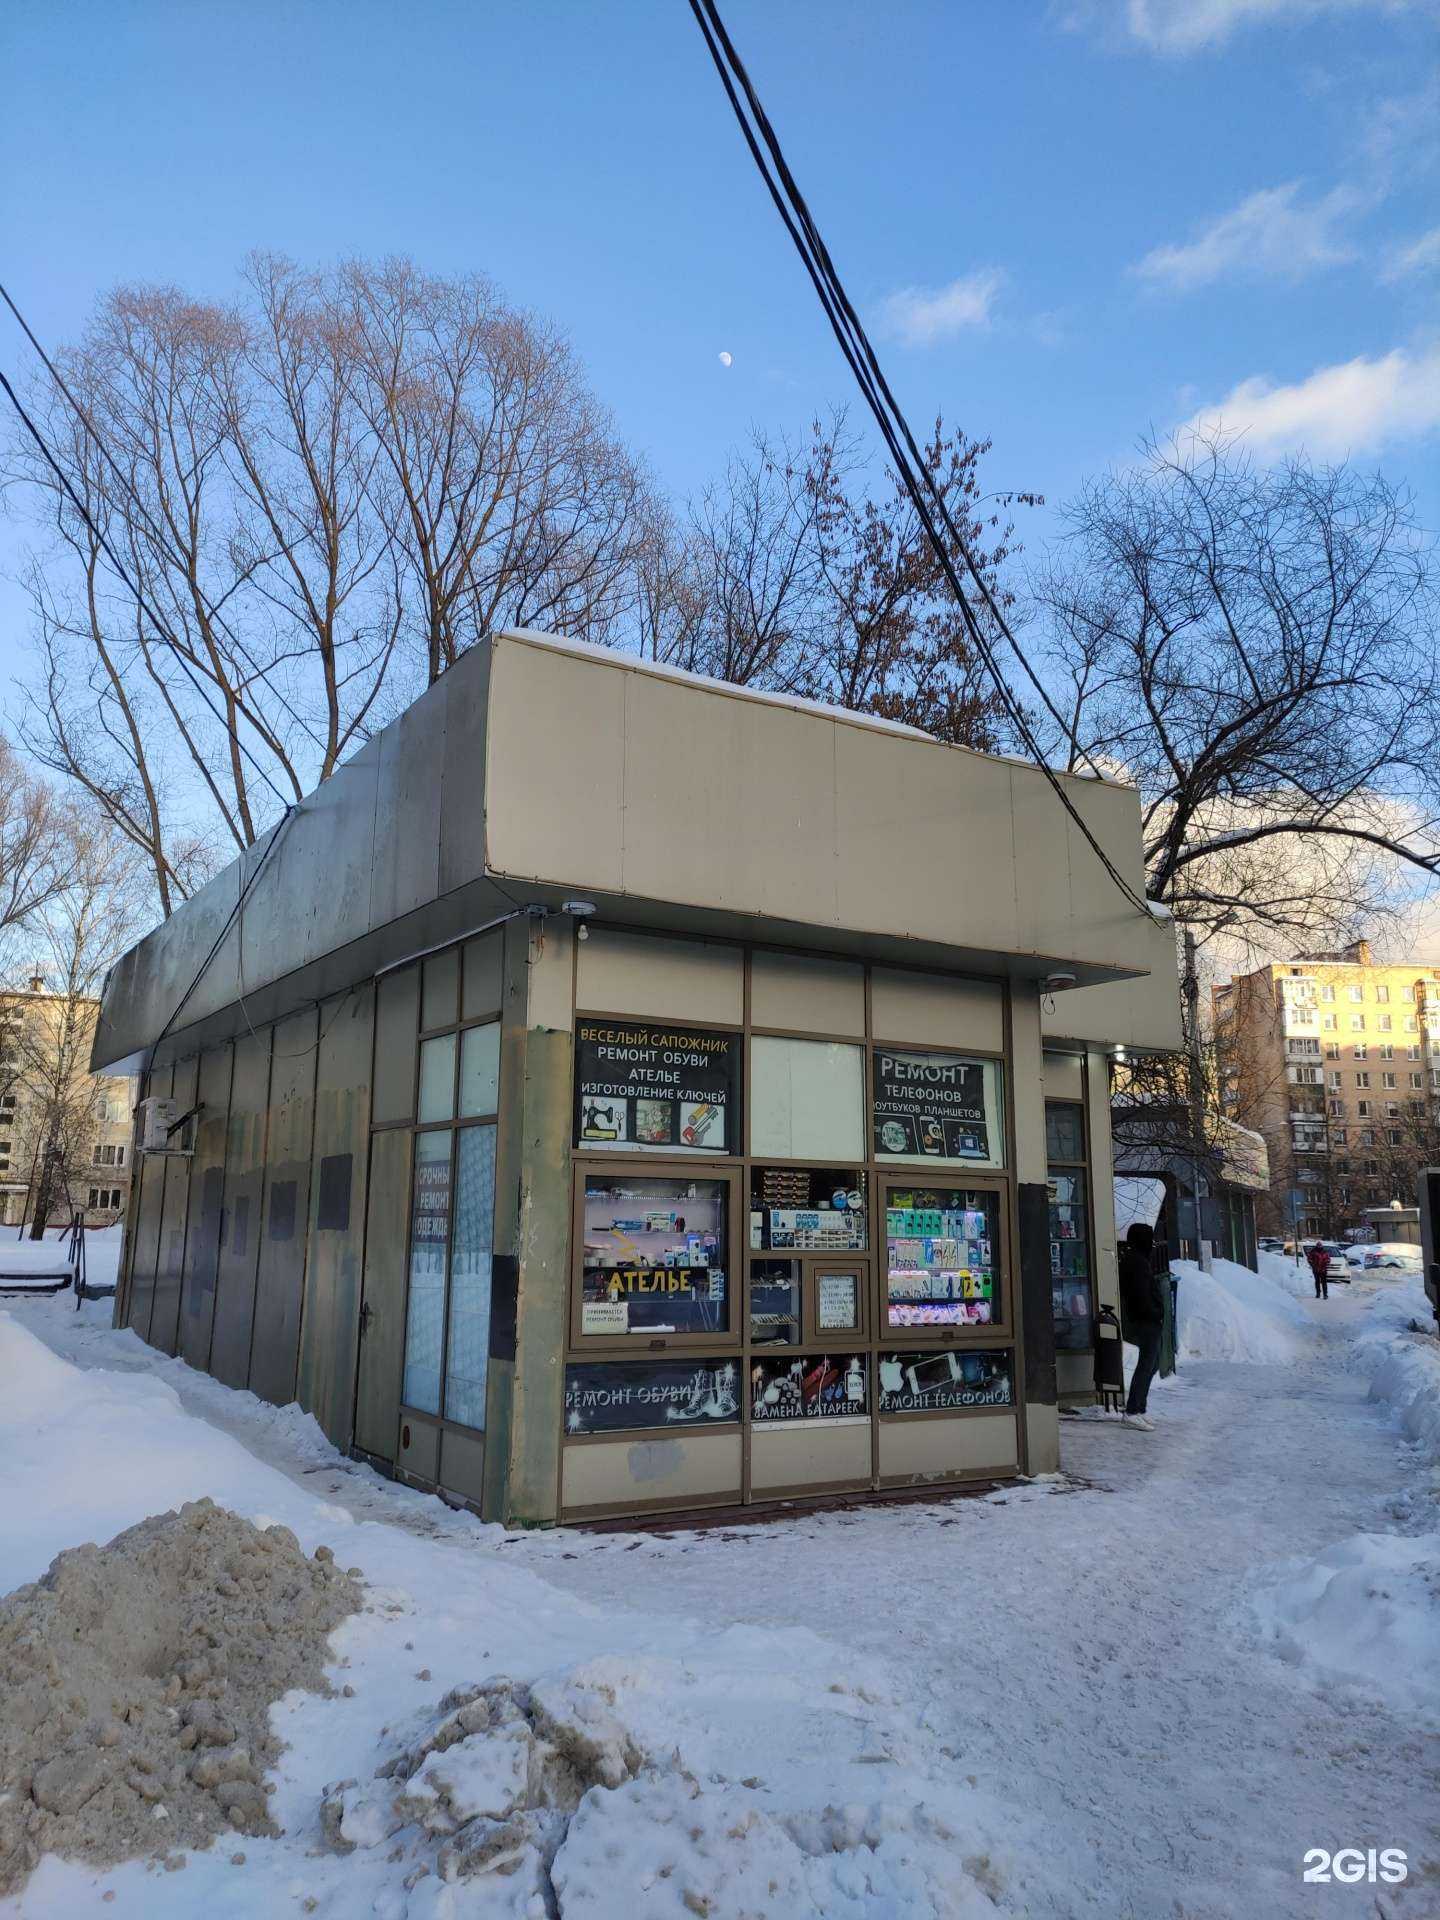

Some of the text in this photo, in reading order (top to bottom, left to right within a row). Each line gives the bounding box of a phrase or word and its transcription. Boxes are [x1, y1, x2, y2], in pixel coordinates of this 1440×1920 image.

[580, 1028, 729, 1053] ВЕСЕЛЫЙ САПОЖНИК
[597, 1047, 708, 1067] РЕМОНТ ОБУВИ
[628, 1068, 681, 1084] АТЕЛЬЕ
[881, 1057, 969, 1085] РЕМОНТ
[581, 1082, 726, 1104] ИЗГОТОВЛЕНИЕ КЛЮЧЕЙ
[885, 1084, 962, 1103] ТЕЛЕФОНОВ
[924, 1105, 981, 1119] ПЛАНШЕТОВ
[608, 1270, 692, 1293] АТЕЛЬЕ
[565, 1385, 693, 1409] РЕМОНТ ОБУВИ
[878, 1391, 1011, 1410] РЕМОНТ ТЕЛЕФОНОВ
[754, 1401, 860, 1418] ЗАМЕНА БАТАРЕЕК
